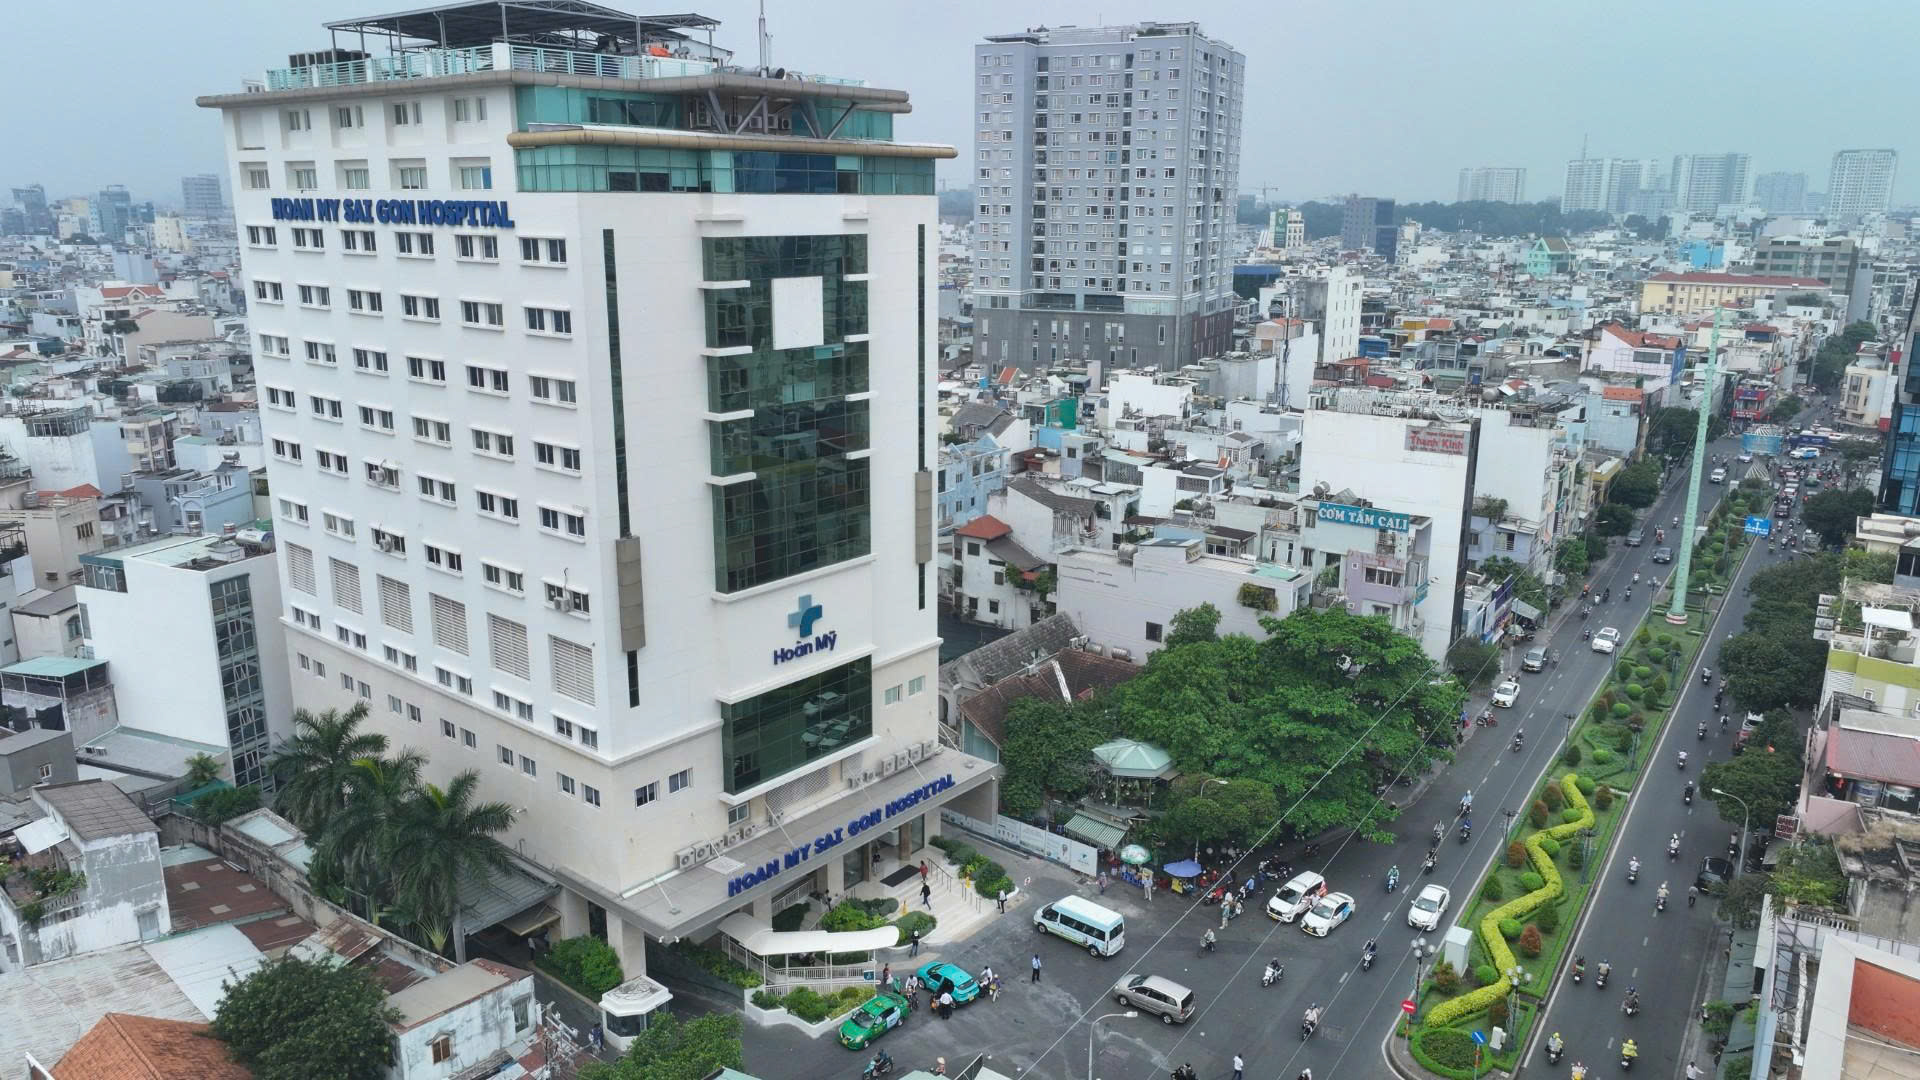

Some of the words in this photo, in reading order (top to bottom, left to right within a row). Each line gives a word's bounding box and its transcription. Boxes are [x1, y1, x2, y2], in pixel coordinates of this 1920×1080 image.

[271, 198, 315, 221] HOAN
[317, 198, 340, 222] MY
[343, 199, 374, 223] SAI
[376, 199, 416, 225] GON
[418, 200, 515, 228] HOSPITAL
[1319, 507, 1344, 521] CƠM
[1378, 516, 1408, 530] CALI
[773, 640, 813, 665] Hoàn
[815, 630, 837, 651] Mỹ
[728, 859, 780, 897] HOAN
[784, 843, 812, 869] MY
[814, 827, 844, 854] SAI
[847, 808, 882, 836] GON
[885, 774, 956, 818] HOSPITAL
